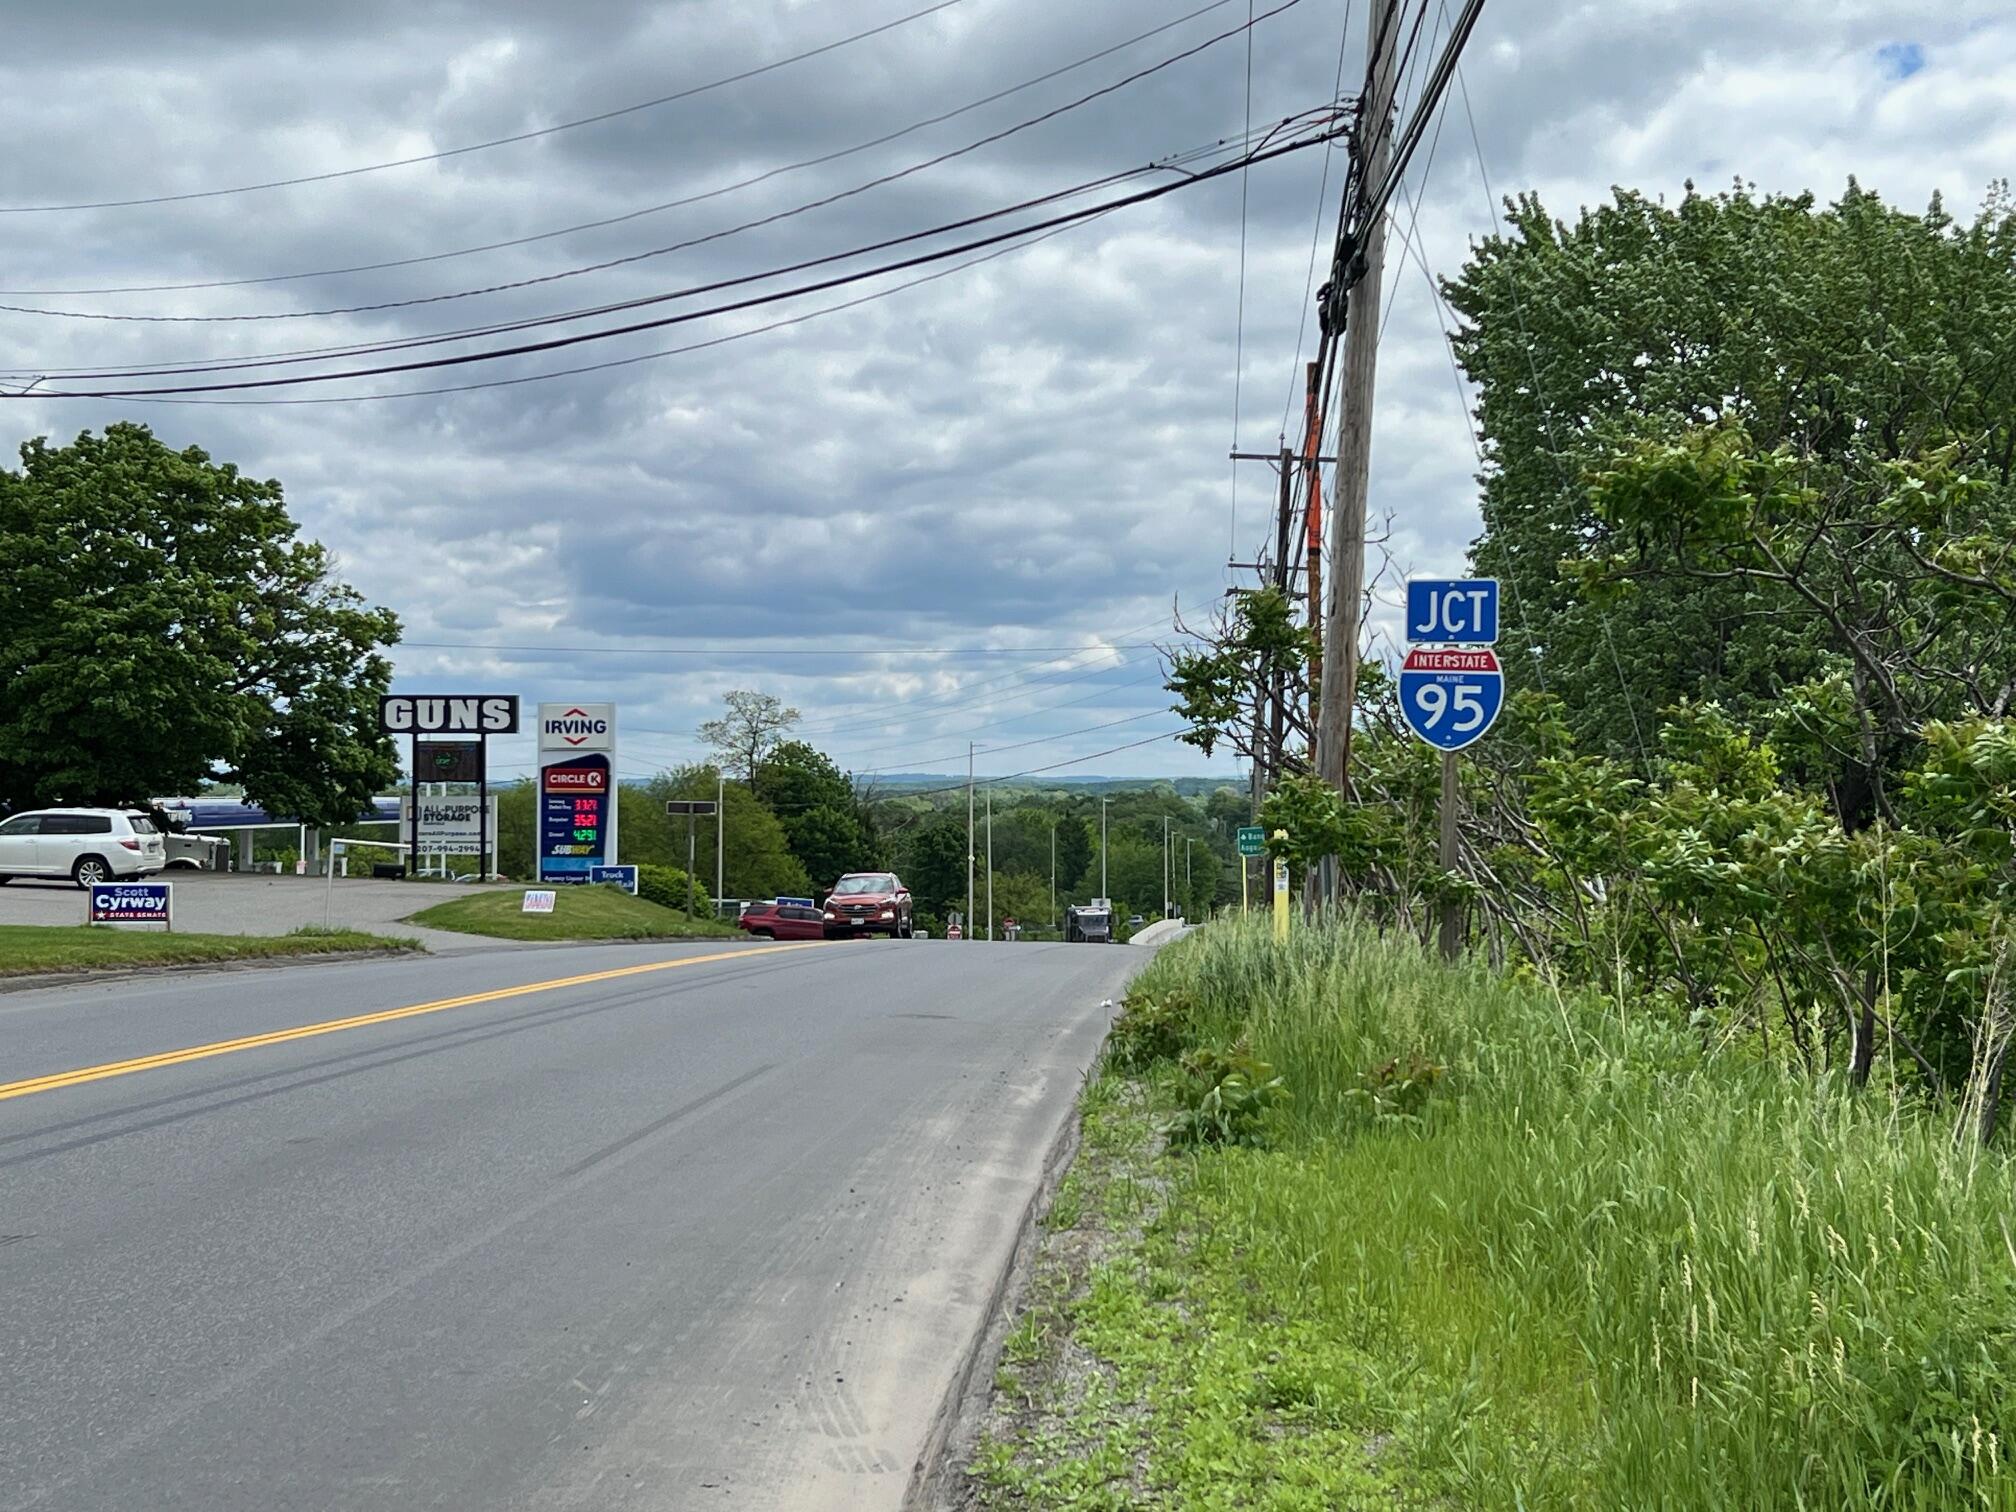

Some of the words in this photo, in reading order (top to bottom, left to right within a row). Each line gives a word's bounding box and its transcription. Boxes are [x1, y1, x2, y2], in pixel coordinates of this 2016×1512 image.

[1416, 591, 1488, 633] JCT
[1413, 654, 1488, 669] INTERSTATE
[1436, 675, 1465, 683] MAINE
[385, 699, 511, 730] GUNS
[1415, 684, 1484, 732] 95
[545, 719, 607, 735] IRVING
[549, 774, 586, 785] CIRCLE
[588, 773, 600, 786] K
[423, 813, 471, 822] STORAGE
[551, 844, 593, 855] SUBWAY
[601, 870, 624, 879] Truck
[114, 887, 149, 896] Scott
[96, 894, 166, 910] Cyrway
